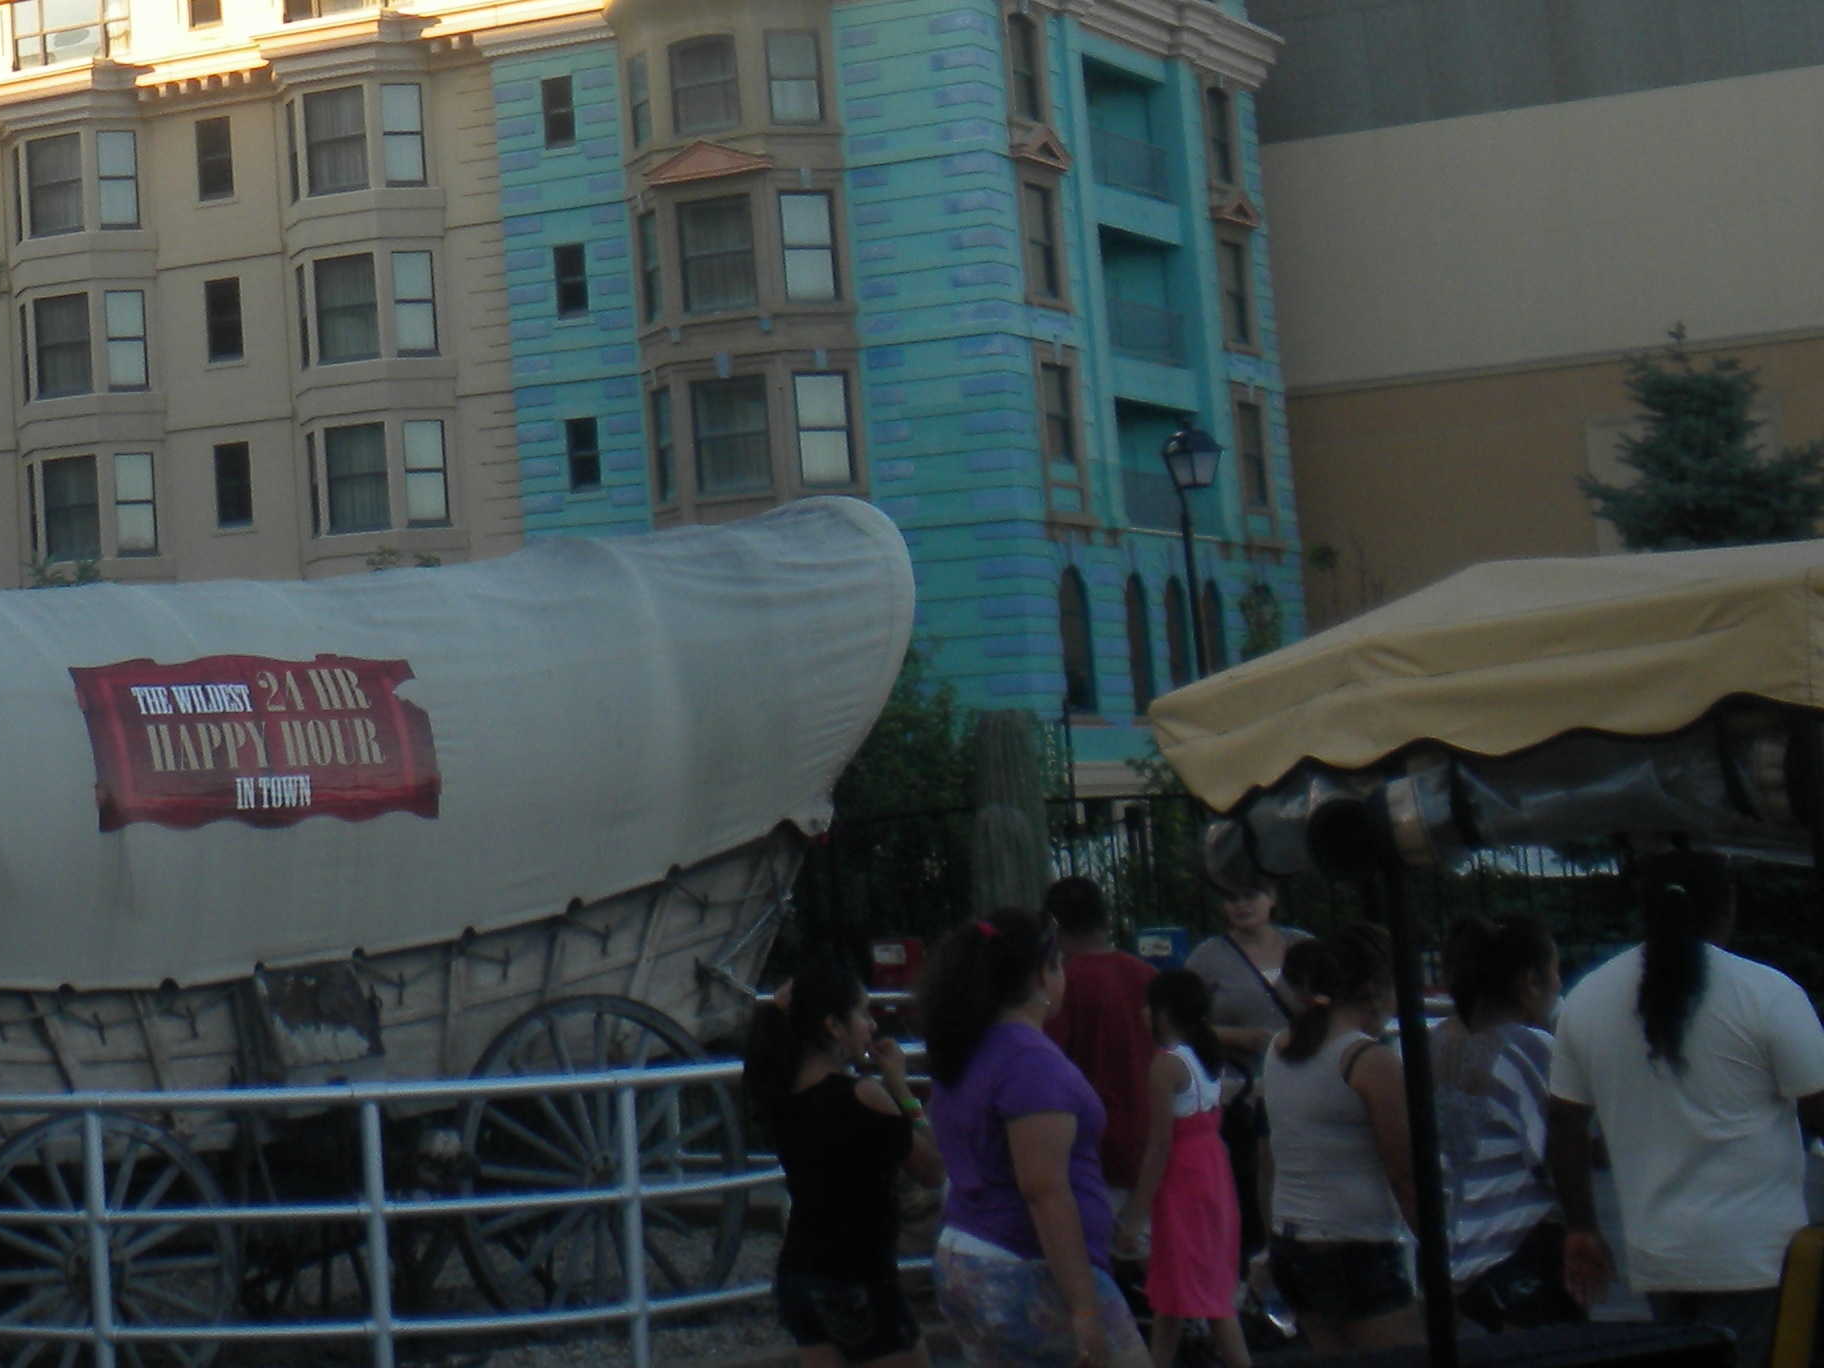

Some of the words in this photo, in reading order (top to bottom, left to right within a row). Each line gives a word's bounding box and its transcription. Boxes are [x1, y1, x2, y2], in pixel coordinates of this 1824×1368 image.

[129, 686, 173, 715] THE
[171, 684, 254, 715] WILDEST
[256, 670, 305, 712] 24
[307, 668, 372, 710] HR
[145, 720, 269, 772] HAPPY
[280, 717, 386, 768] HOUR
[235, 776, 255, 810] IN
[258, 774, 312, 809] TOWN
